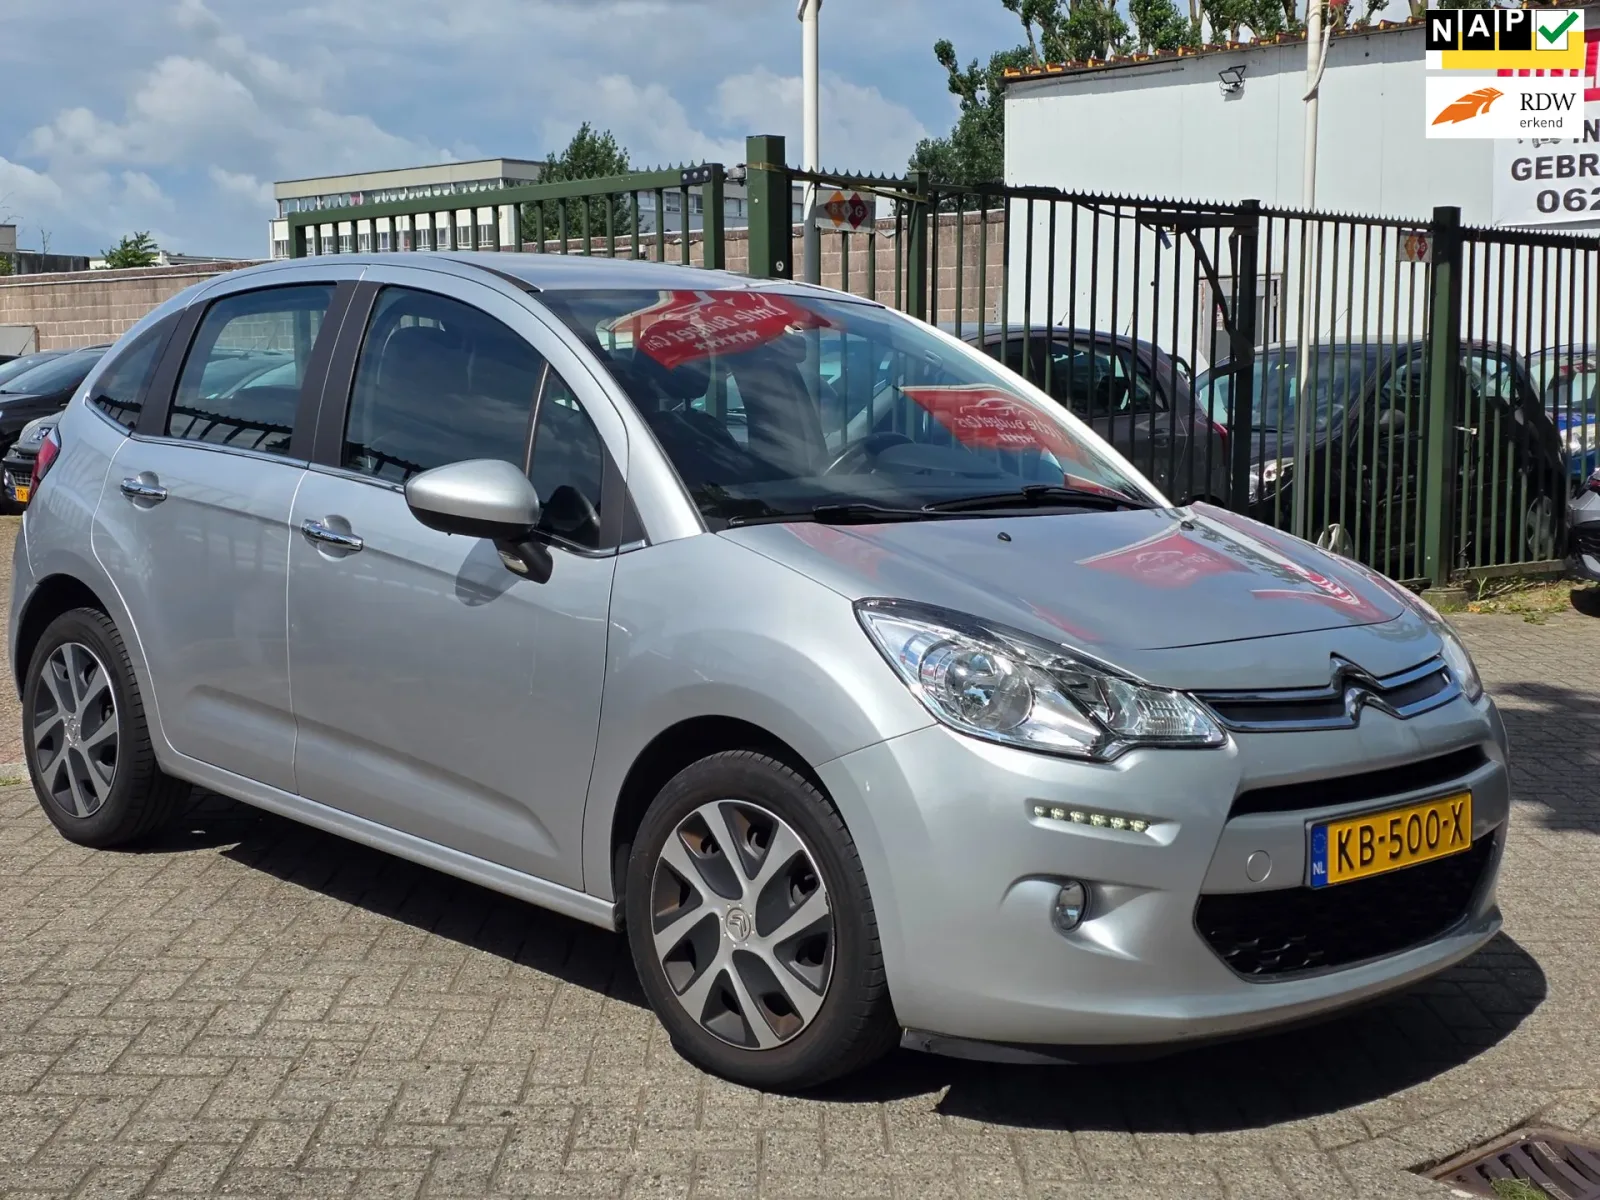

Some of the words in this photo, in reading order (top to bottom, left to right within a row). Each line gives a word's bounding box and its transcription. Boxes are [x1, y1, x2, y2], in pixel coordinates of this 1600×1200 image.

[1511, 153, 1600, 181] GEBR
[1337, 801, 1465, 873] KB-500-X
[1313, 861, 1326, 876] NL
